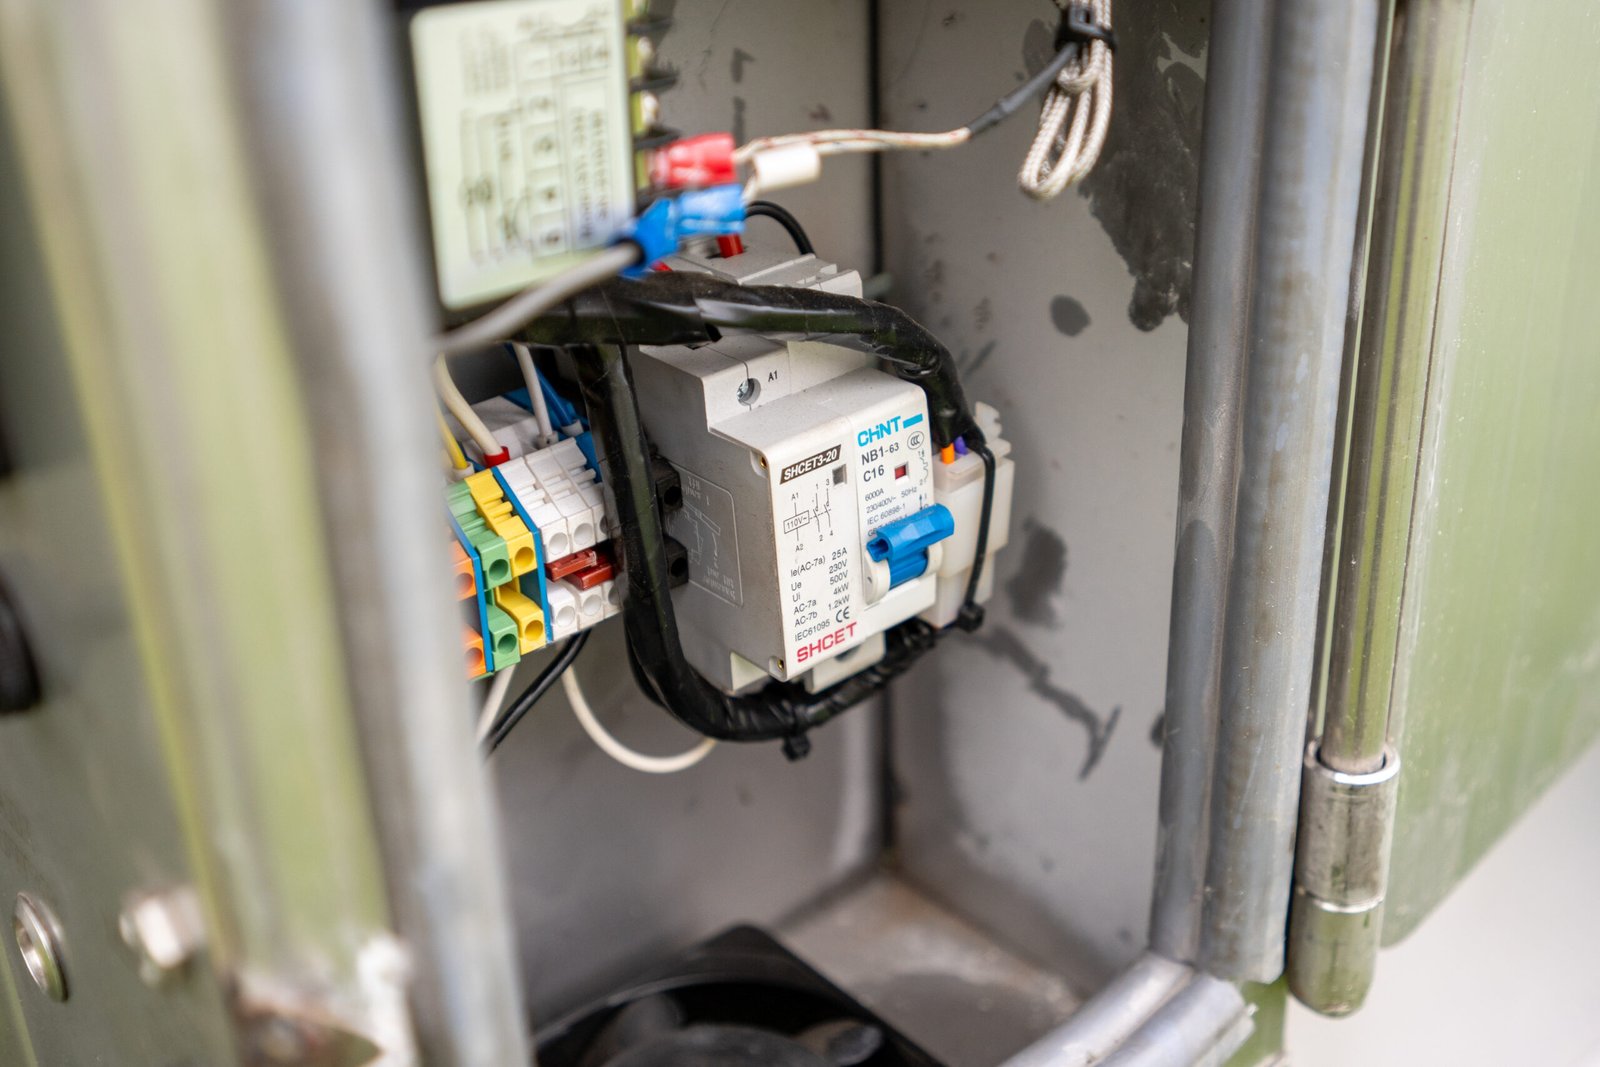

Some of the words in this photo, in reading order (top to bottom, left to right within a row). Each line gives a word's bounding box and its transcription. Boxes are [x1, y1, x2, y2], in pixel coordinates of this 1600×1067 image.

[768, 370, 778, 382] A1
[783, 449, 838, 481] SHCET3-20
[861, 442, 900, 466] NB1-63
[863, 464, 885, 483] C16
[791, 492, 799, 501] A1
[864, 488, 884, 501] 6000A
[868, 514, 879, 525] IEC
[795, 544, 804, 552] A2
[832, 547, 848, 560] 25A
[791, 582, 802, 592] Ue
[829, 559, 848, 574] 230V
[792, 593, 801, 602] Ui
[830, 570, 849, 585] 500V
[794, 600, 817, 614] AC-7a
[834, 582, 850, 596] 4kW
[795, 611, 818, 627] AC-7b
[828, 594, 850, 611] 1.2kW
[795, 619, 831, 642] IEC61095
[797, 621, 857, 662] SHCET
